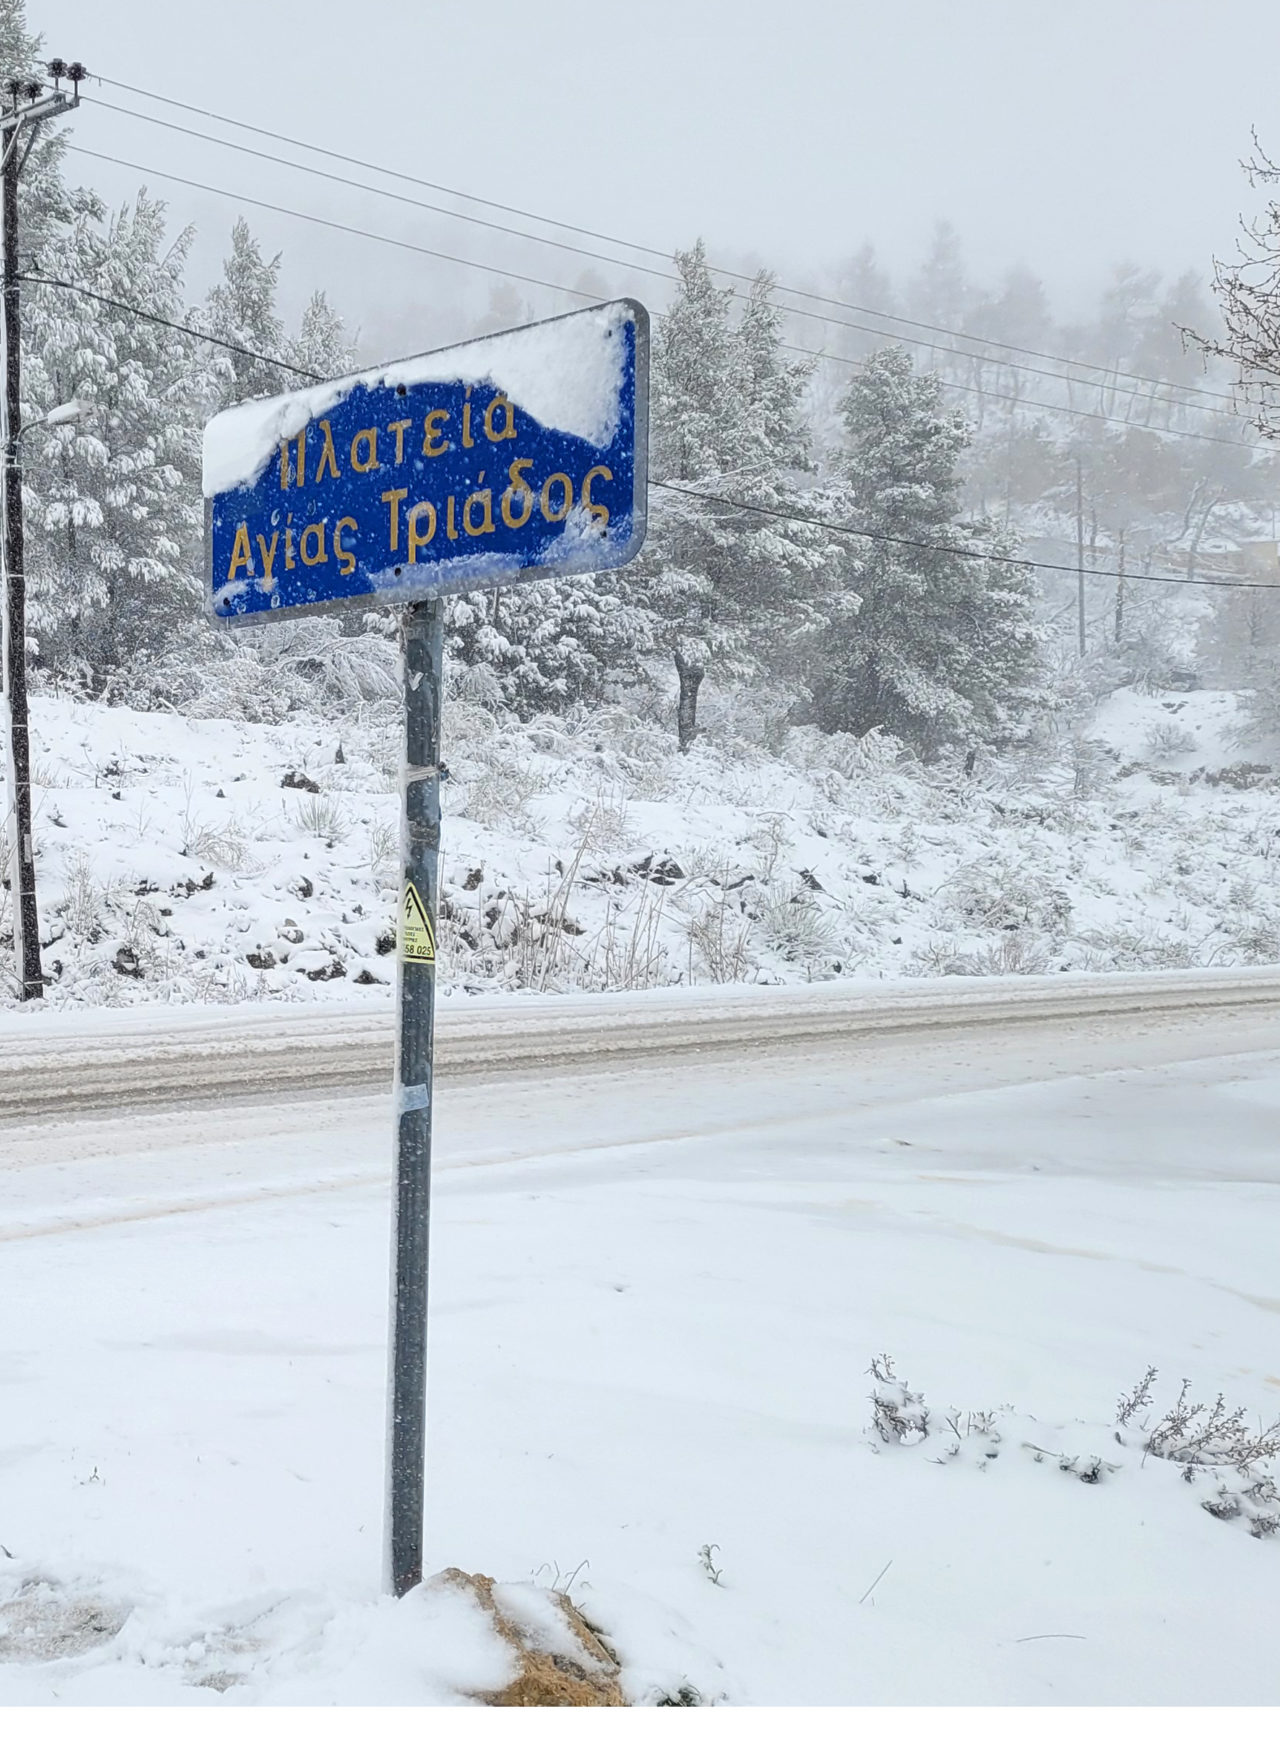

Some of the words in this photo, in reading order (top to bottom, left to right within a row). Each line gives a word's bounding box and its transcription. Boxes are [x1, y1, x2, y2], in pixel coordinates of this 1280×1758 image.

[227, 513, 358, 591] Αγίας
[381, 458, 614, 564] Τριάδος
[416, 945, 432, 956] 025
